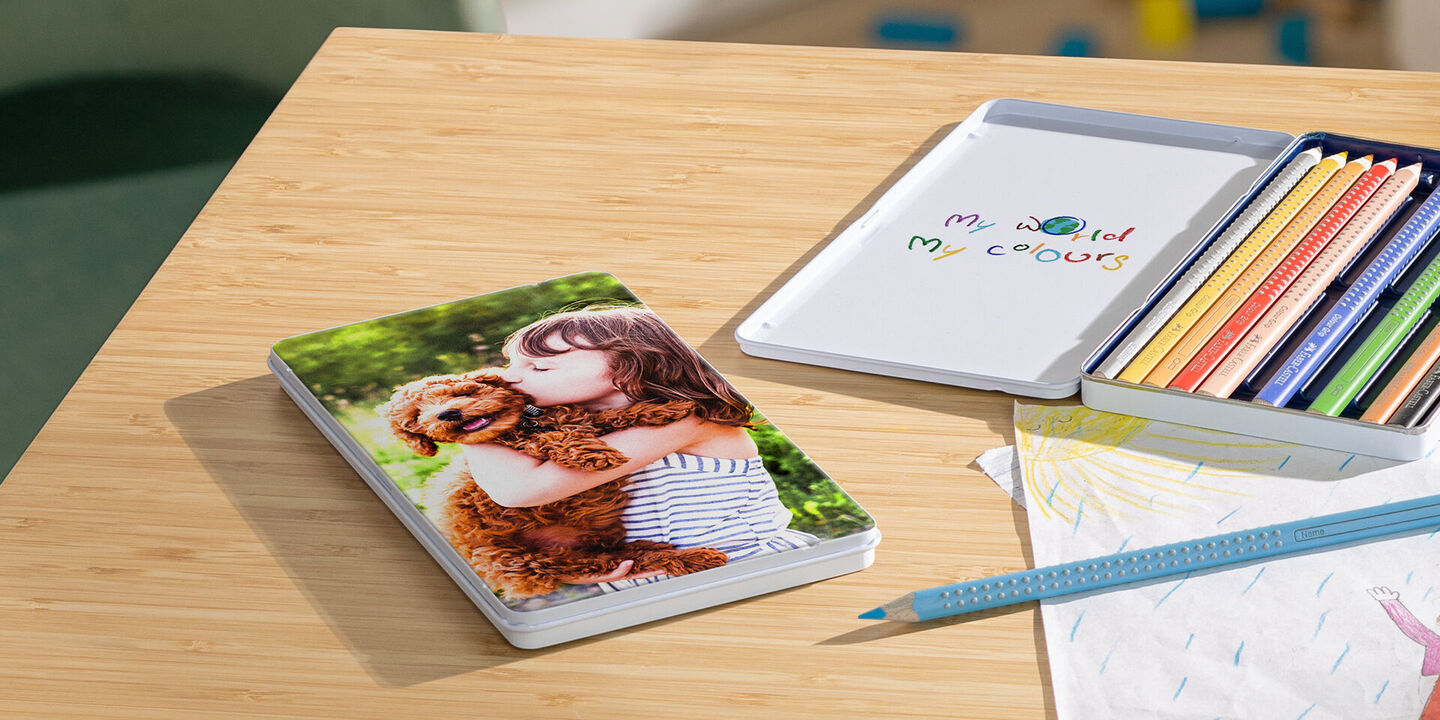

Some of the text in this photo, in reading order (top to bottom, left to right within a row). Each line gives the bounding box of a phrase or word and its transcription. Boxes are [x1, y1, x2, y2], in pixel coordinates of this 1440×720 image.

[944, 213, 996, 234] My
[908, 235, 1129, 271] My colours
[1317, 313, 1343, 338] Colour Grip
[1274, 349, 1312, 386] FABER-CASTELL
[1301, 529, 1325, 539] Name
